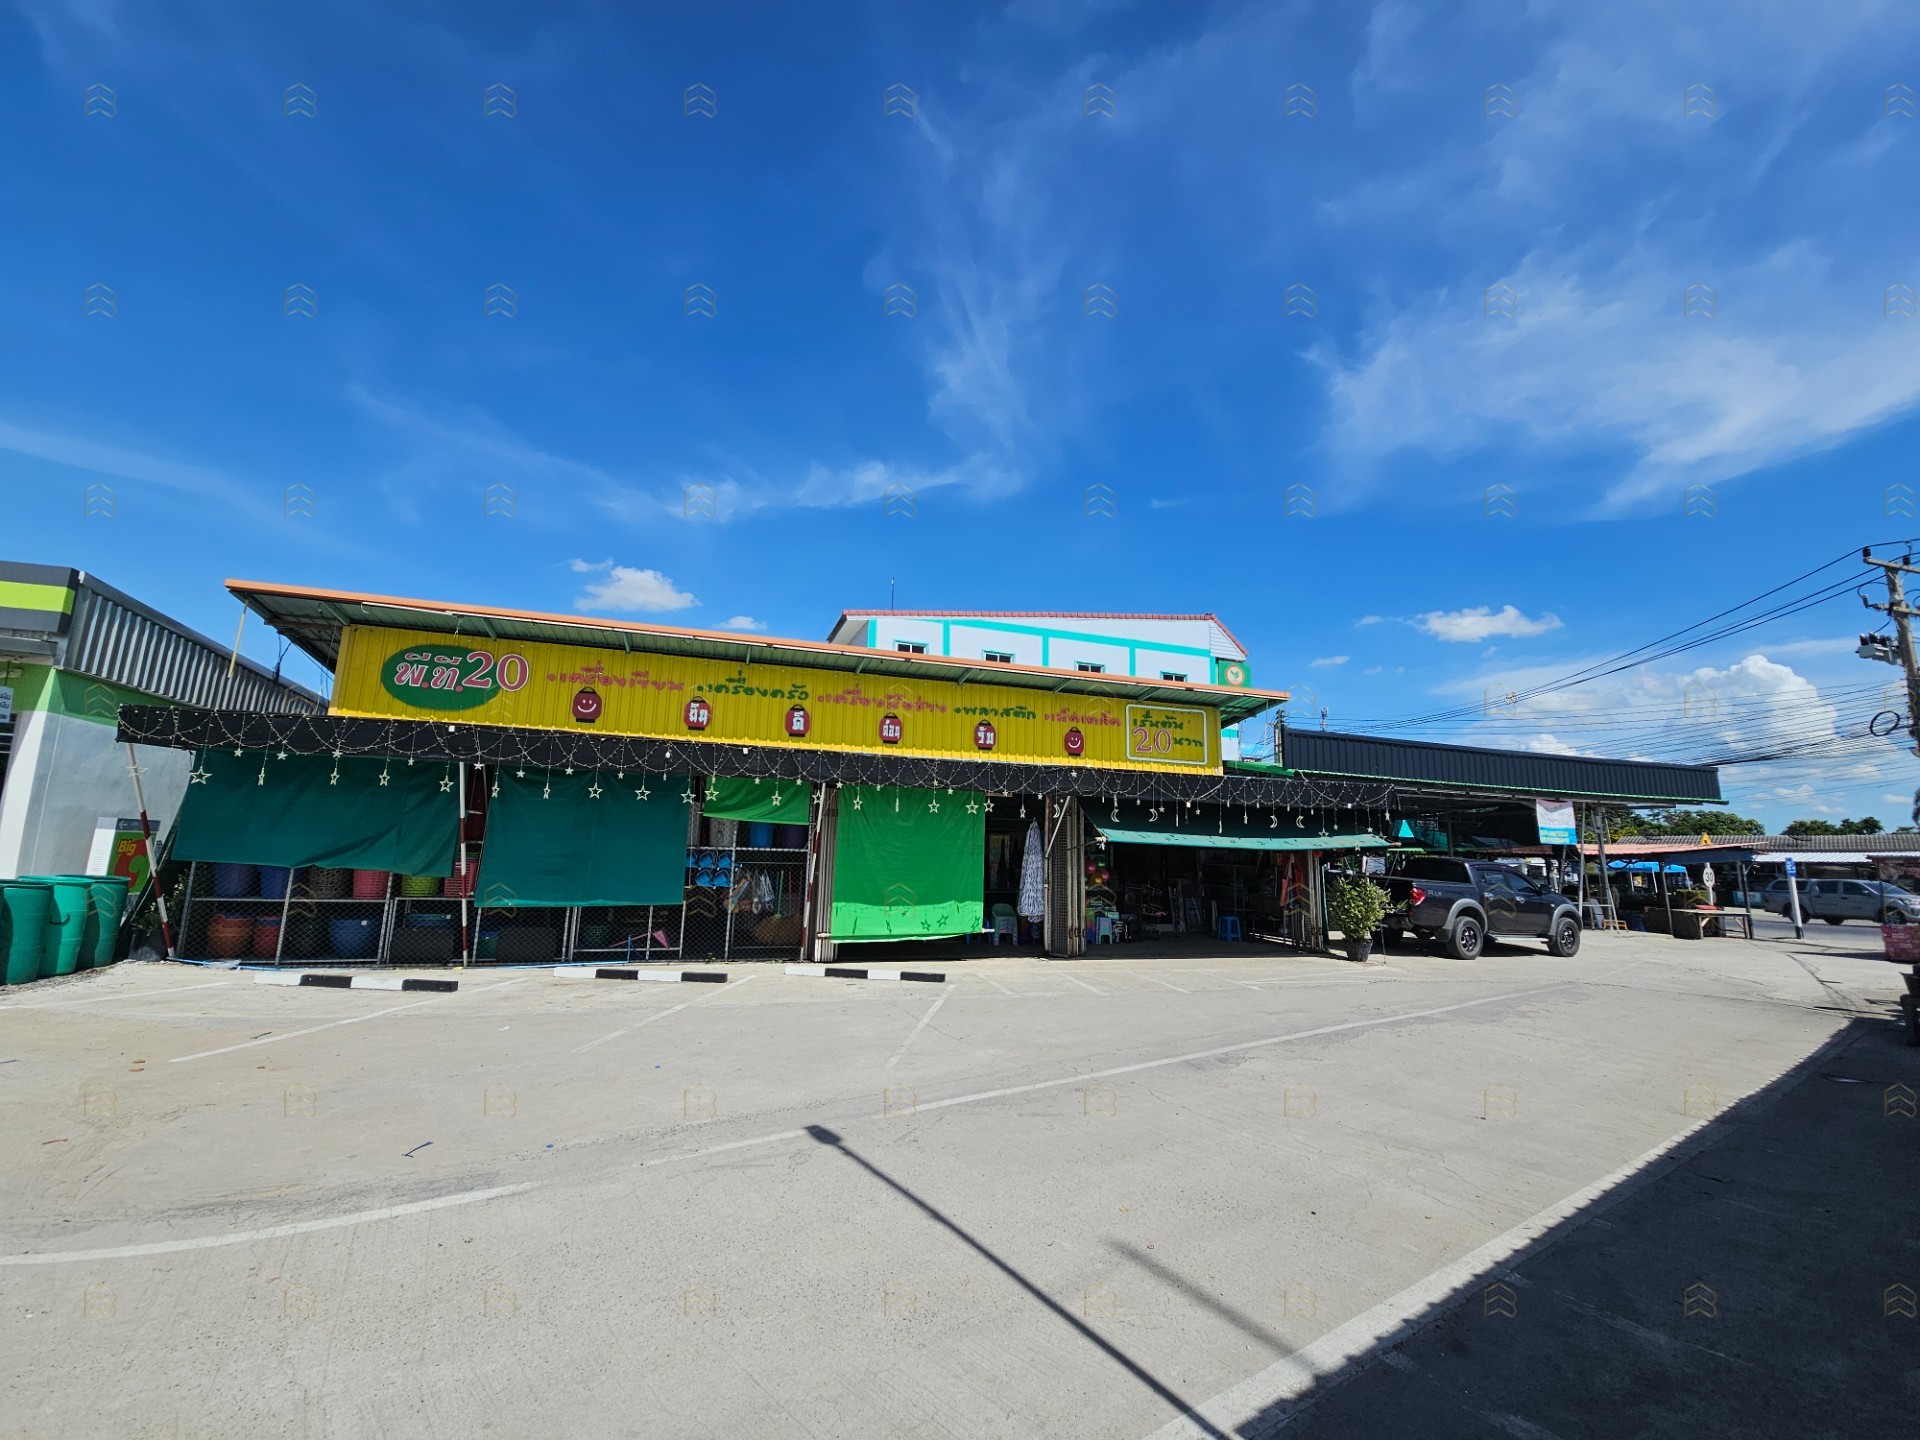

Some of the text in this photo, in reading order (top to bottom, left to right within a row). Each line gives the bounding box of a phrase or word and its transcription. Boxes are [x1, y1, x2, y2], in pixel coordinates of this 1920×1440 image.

[560, 660, 684, 691] เครื่องเขียน
[707, 670, 809, 700] เครื่องครัว
[963, 705, 1037, 720] พลาสติก
[1133, 710, 1184, 730] เริ่มต้น
[1133, 727, 1203, 753] 20 บาท
[118, 840, 137, 856] Big
